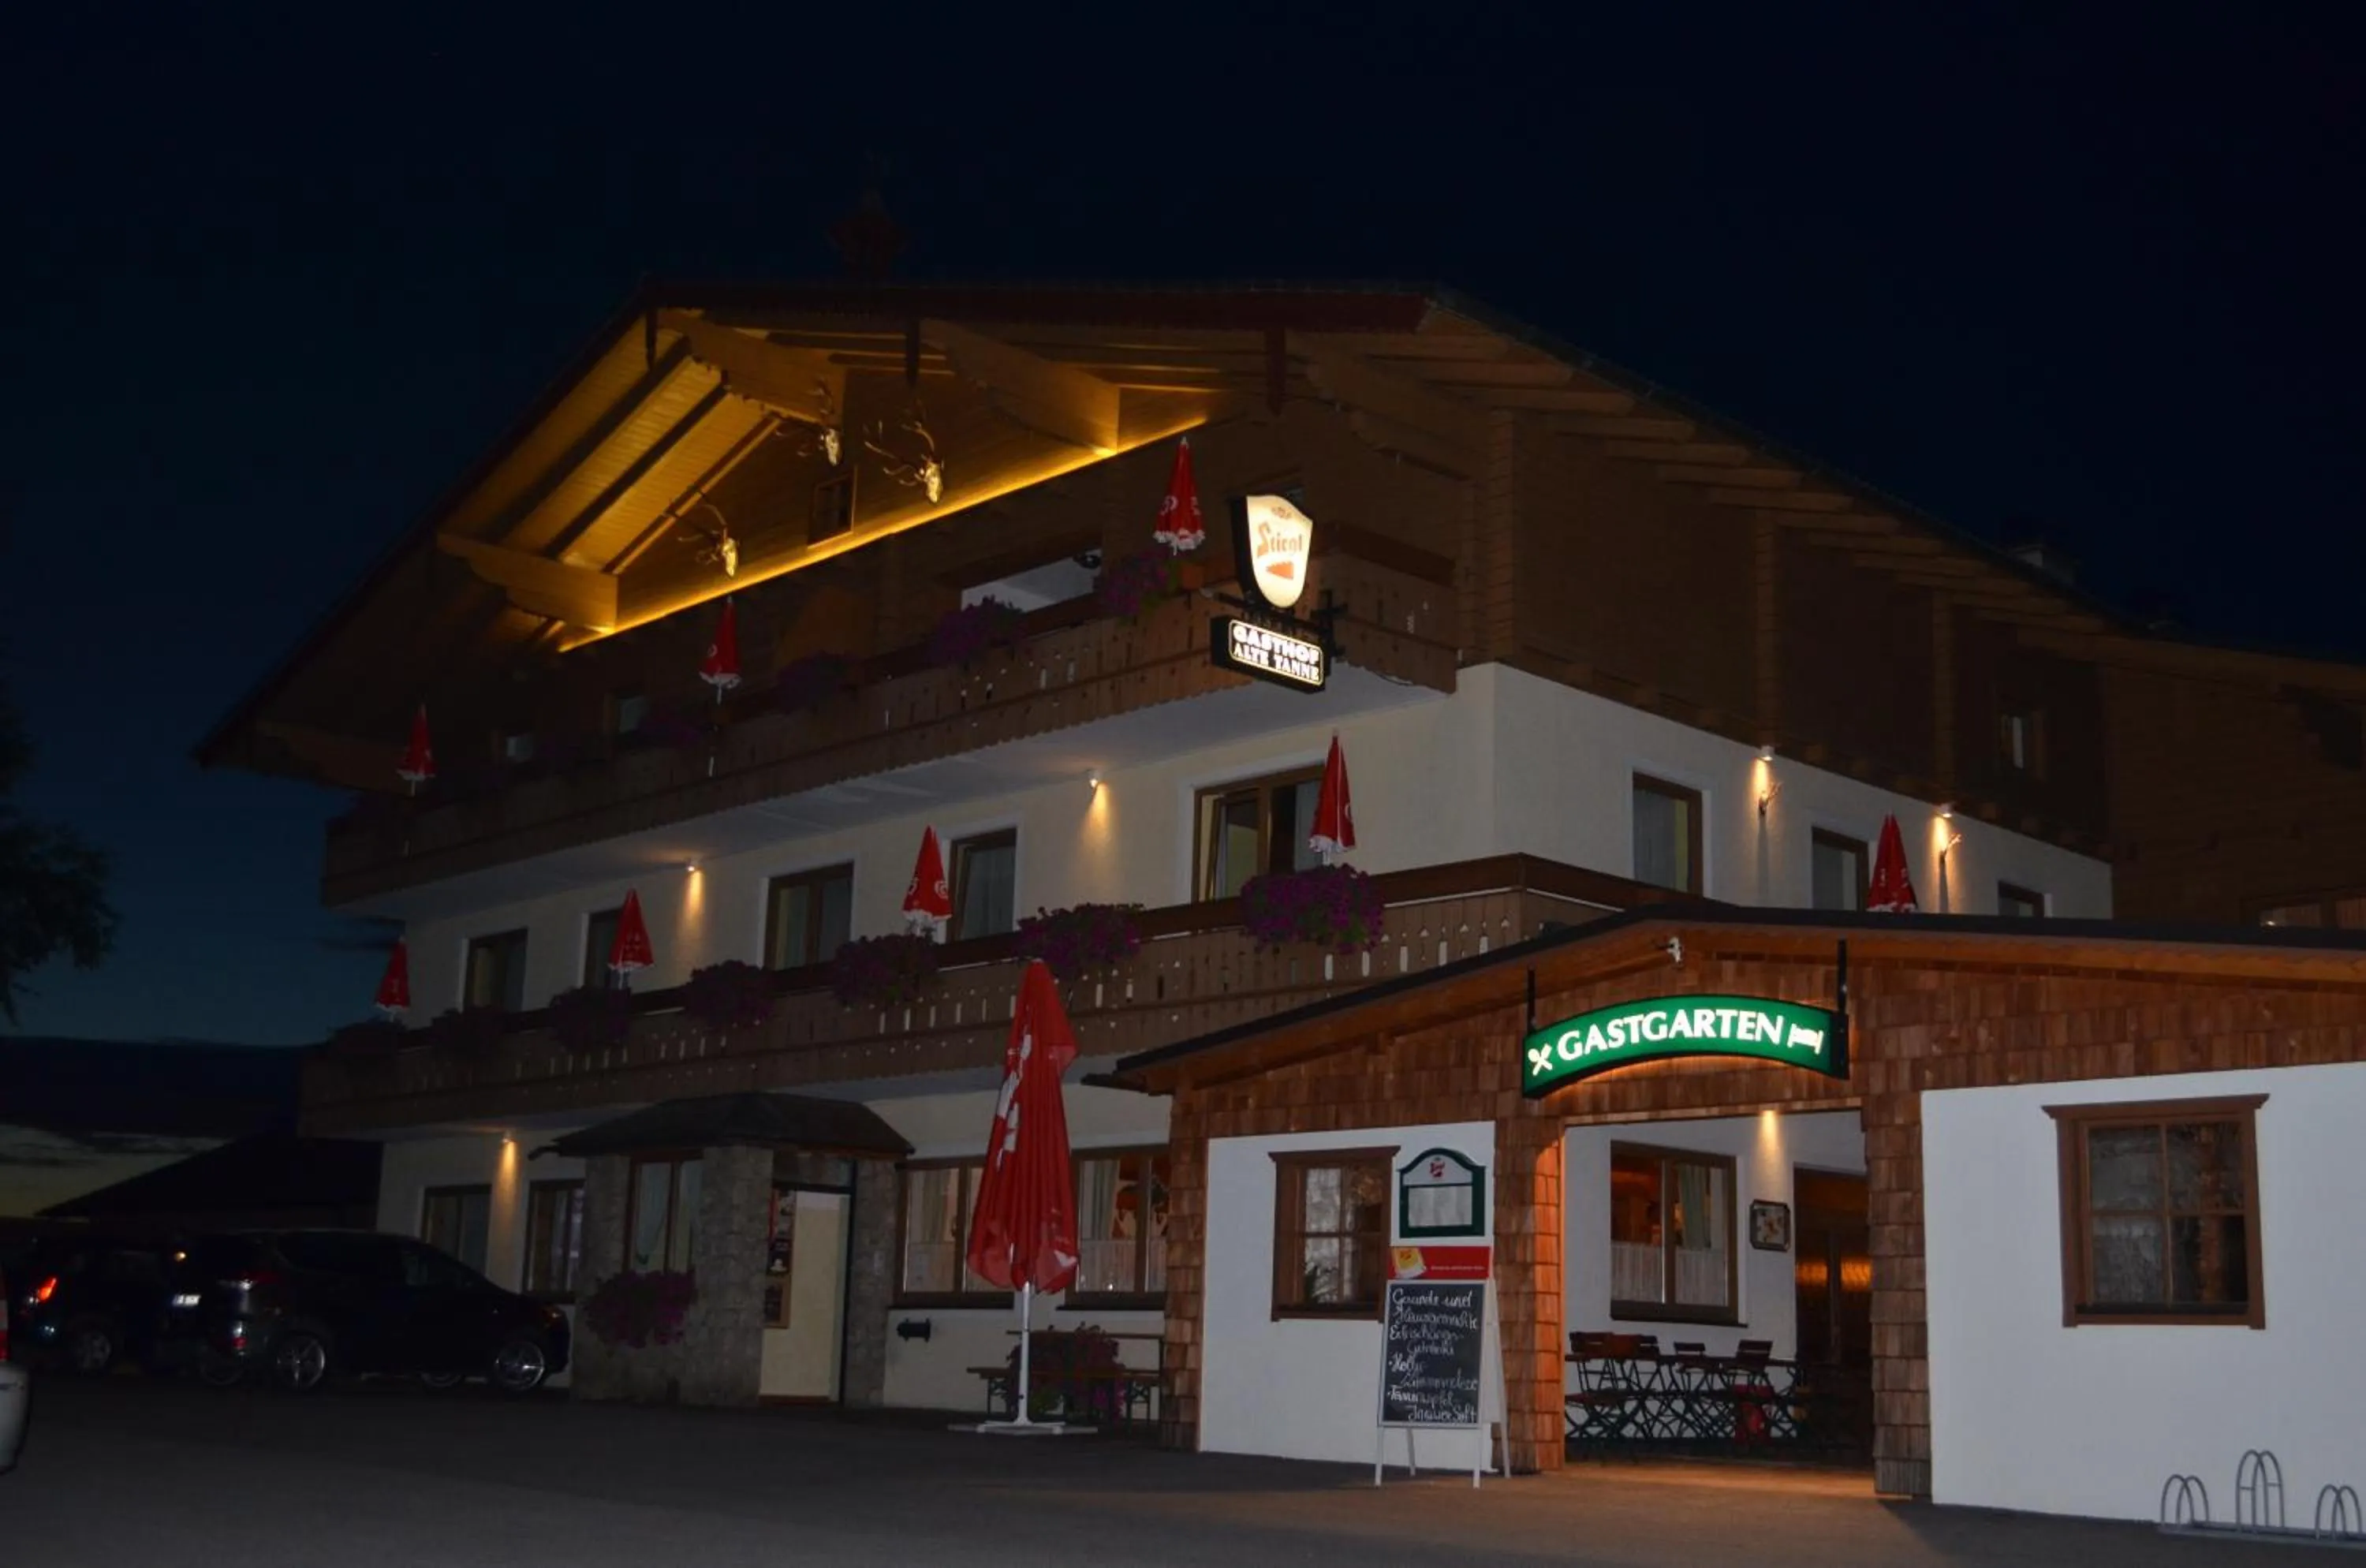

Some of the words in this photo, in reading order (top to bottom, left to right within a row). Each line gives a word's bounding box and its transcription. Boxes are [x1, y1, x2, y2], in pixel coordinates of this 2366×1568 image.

[1233, 625, 1319, 665] GASTHOF
[1233, 643, 1270, 666] ALTE
[1274, 655, 1320, 681] TANNE
[1557, 1009, 1783, 1061] GASTGARTEN
